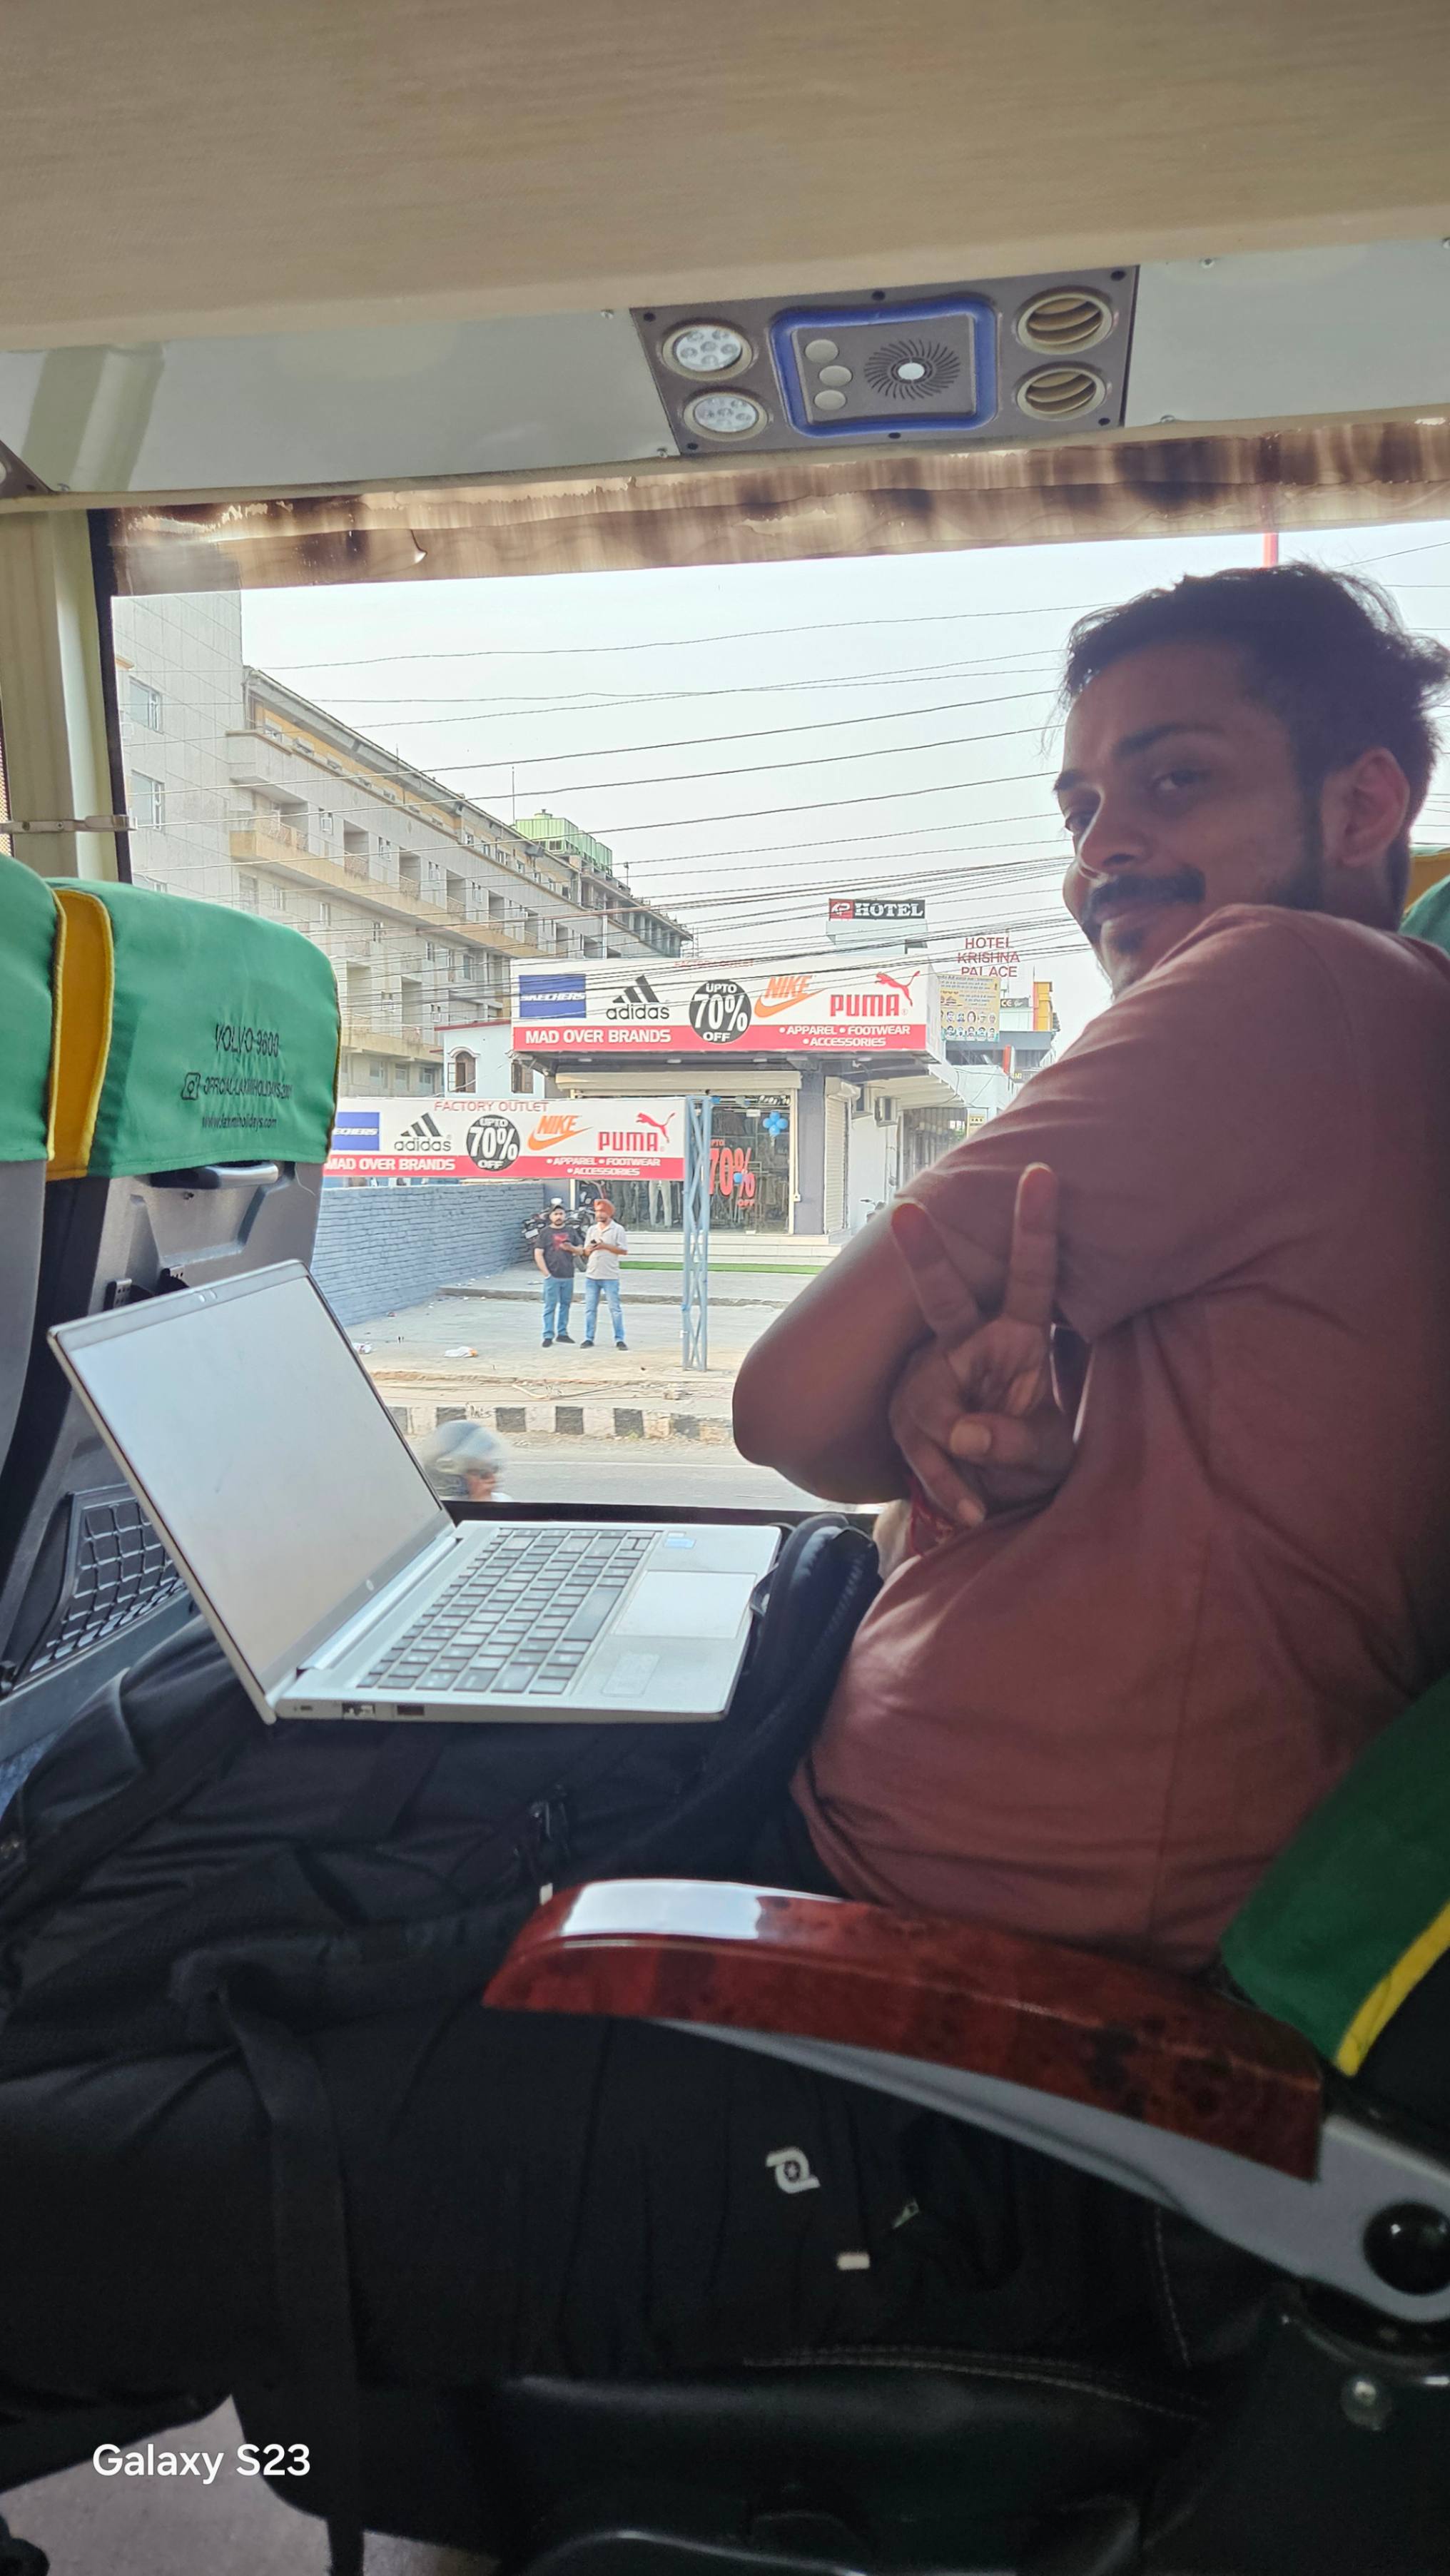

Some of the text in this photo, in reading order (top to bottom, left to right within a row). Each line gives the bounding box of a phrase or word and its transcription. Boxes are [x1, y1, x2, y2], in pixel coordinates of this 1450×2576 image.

[855, 903, 923, 917] HOTEL
[965, 937, 1014, 949] HOTEL
[958, 951, 1020, 963] KRISHNA
[961, 966, 1018, 978] PALACE
[706, 983, 738, 993] UPTO
[764, 975, 814, 999] NIKE
[606, 1004, 670, 1020] adidas
[830, 994, 900, 1017] PUMA
[692, 993, 749, 1032] 70%
[525, 1029, 671, 1044] MAD OVER BRANDS
[786, 1025, 911, 1035] APPAREL FOOTWEAR
[702, 1032, 731, 1042] OFF
[809, 1037, 887, 1047] ACCESSORIES
[434, 1101, 549, 1112] FACTORY OUTLET
[479, 1117, 509, 1127] UPTO
[537, 1115, 582, 1135] NIKE
[394, 1137, 452, 1152] adidas
[469, 1126, 519, 1162] 70%
[598, 1131, 659, 1152] PUMA
[325, 1157, 455, 1171] MAD OVER BRANDS
[477, 1160, 504, 1170] OFF
[553, 1157, 661, 1167] APPAREL FOOTWEAR
[573, 1167, 640, 1177] ACCESSORIES
[709, 1147, 756, 1198] 70%
